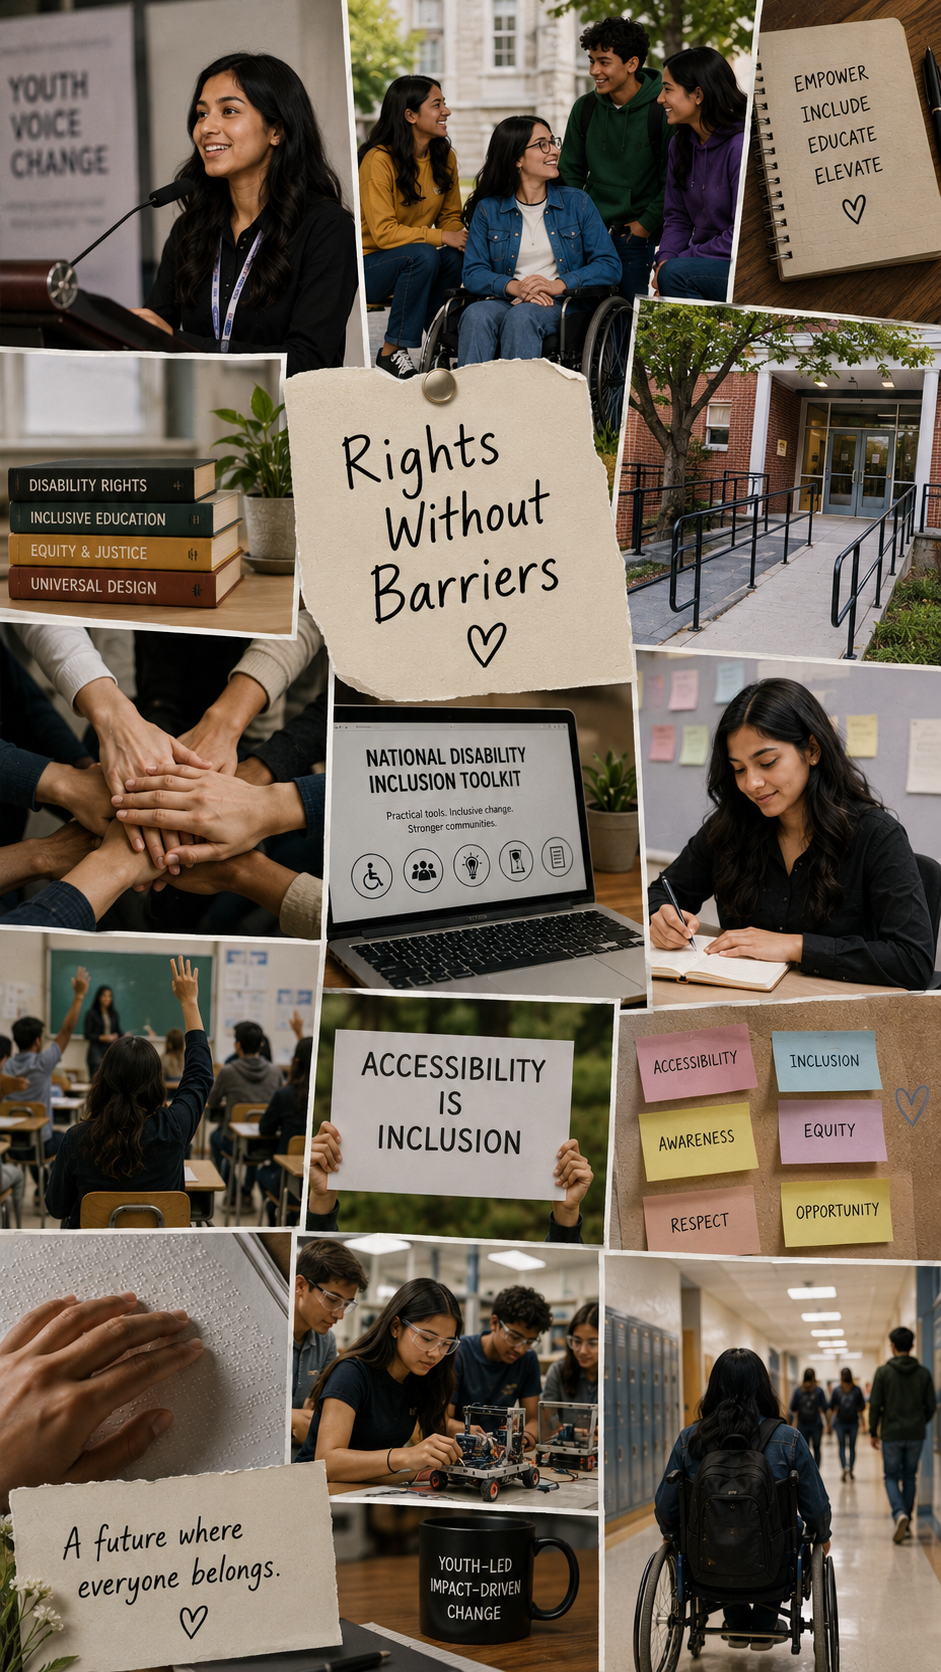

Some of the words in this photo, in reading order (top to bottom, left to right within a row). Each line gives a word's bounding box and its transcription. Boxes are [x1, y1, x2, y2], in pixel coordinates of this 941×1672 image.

[8, 71, 88, 104] YOUTH
[794, 65, 869, 92] EMPOWER
[801, 95, 871, 123] INCLUDE
[10, 109, 81, 141] VOICE
[808, 126, 877, 154] EDUCATE
[11, 145, 108, 179] CHANGE
[815, 157, 883, 185] ELEVATE
[342, 423, 499, 500] Rights
[29, 478, 97, 492] DISABILITY
[101, 478, 147, 493] RIGHTS
[30, 511, 91, 525] INCLUSIVE
[96, 512, 166, 526] EDUCATION
[385, 478, 550, 551] Without
[31, 544, 76, 558] EQUITY
[81, 546, 90, 558] &
[95, 546, 147, 560] JUSTICE
[31, 577, 103, 593] UNIVERSAL
[107, 579, 157, 595] DESIGN
[370, 558, 559, 624] Barriers
[366, 748, 446, 767] NATIONAL
[450, 747, 526, 765] DISABILITY
[369, 772, 456, 793] INCLUSION
[460, 770, 521, 789] TOOLKIT
[386, 809, 423, 821] Practical
[424, 808, 447, 819] tools.
[449, 806, 483, 817] Inclusive
[484, 804, 514, 815] change.
[408, 822, 443, 834] Stronger
[445, 819, 497, 831] communities.
[361, 1051, 546, 1083] ACCESSIBILITY
[653, 1050, 738, 1075] ACCESSIBILITY
[790, 1054, 859, 1068] INCLUSION
[439, 1091, 462, 1116] IS
[378, 1124, 521, 1155] INCLUSION
[659, 1129, 735, 1152] AWARENESS
[804, 1123, 856, 1139] EQUITY
[671, 1212, 729, 1233] RESPECT
[796, 1202, 880, 1220] OPPORTUNITY
[62, 1525, 82, 1560] A
[94, 1523, 167, 1562] future
[179, 1516, 243, 1545] where
[438, 1555, 512, 1574] YOUTH-LED
[78, 1571, 179, 1606] everyone
[191, 1554, 281, 1592] belongs.
[430, 1577, 521, 1598] IMPACT-DRIVEN
[447, 1604, 501, 1621] CHANGE
